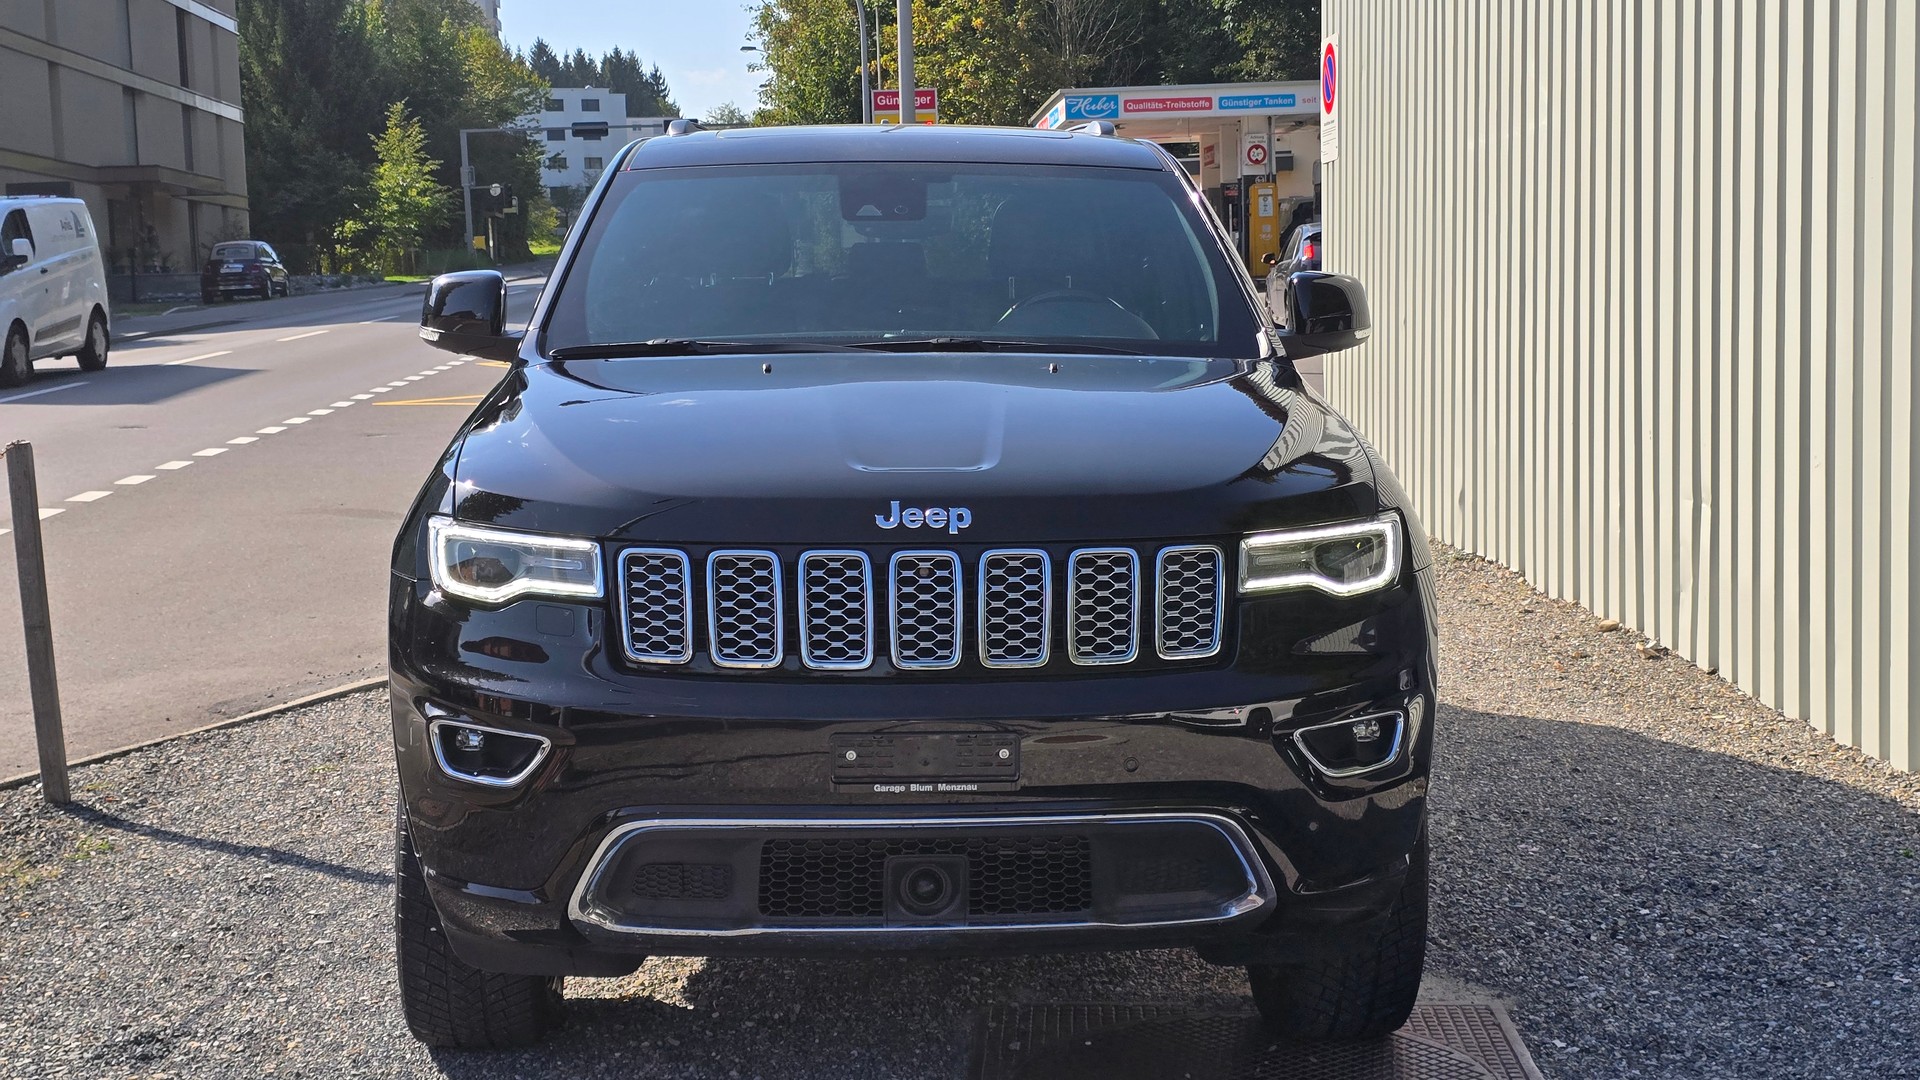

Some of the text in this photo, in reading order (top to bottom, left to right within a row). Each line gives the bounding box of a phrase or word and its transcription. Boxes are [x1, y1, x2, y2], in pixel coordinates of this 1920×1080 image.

[877, 95, 931, 106] Günger
[1126, 100, 1210, 110] Qualitäts-Treibstoffe
[1221, 97, 1293, 108] Günstiger Tanken
[1066, 97, 1117, 117] Huber
[875, 501, 972, 534] Jeep
[873, 783, 978, 793] Garage Blum Menznau
